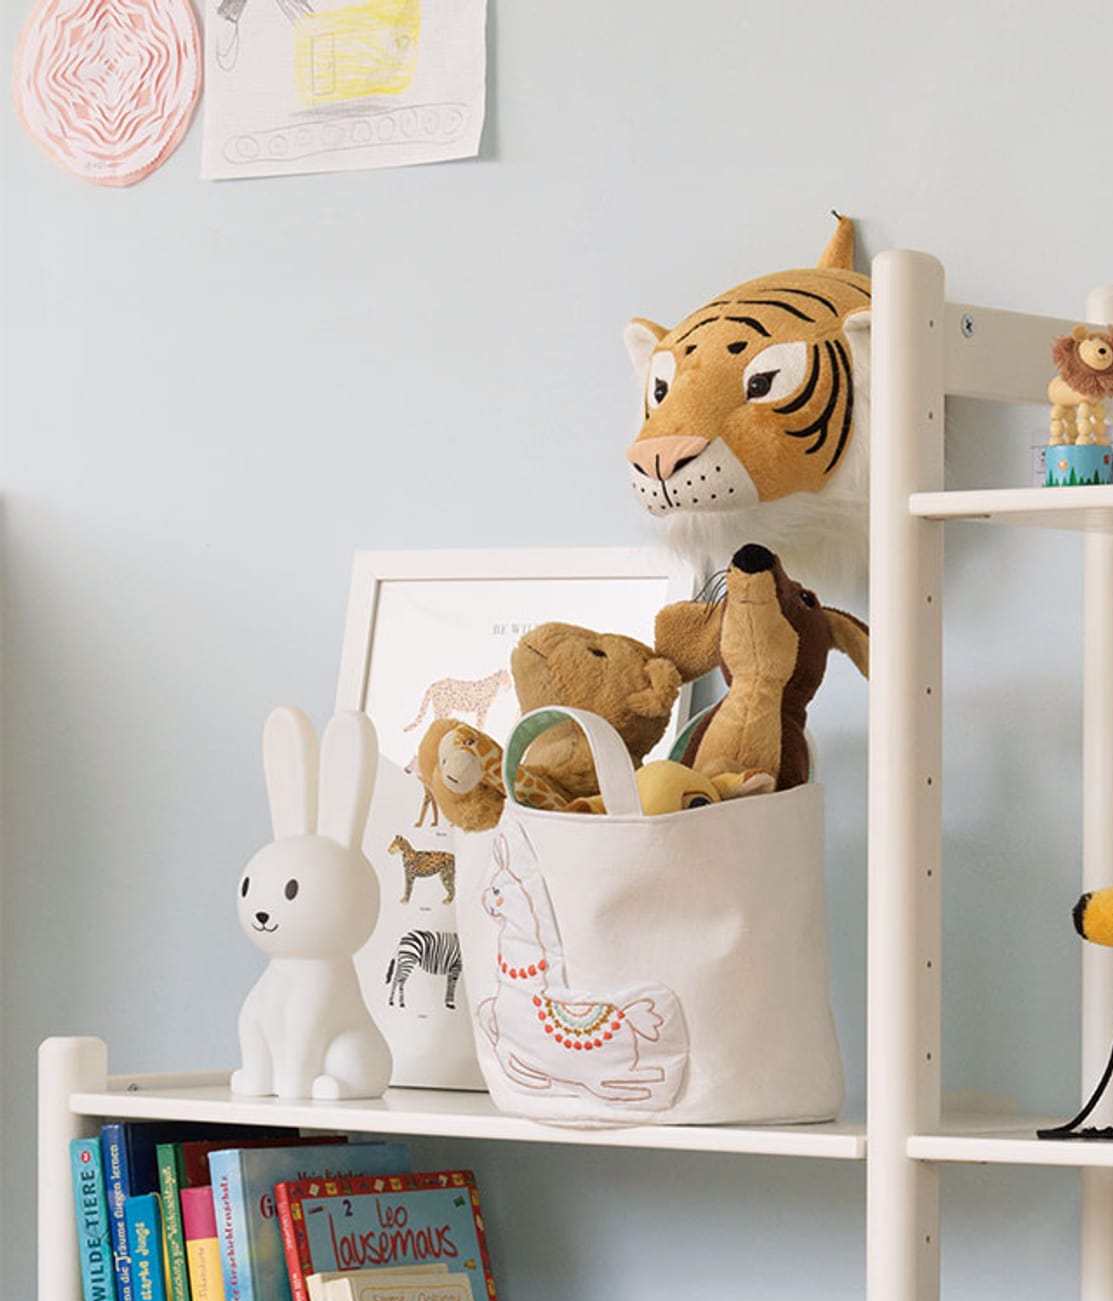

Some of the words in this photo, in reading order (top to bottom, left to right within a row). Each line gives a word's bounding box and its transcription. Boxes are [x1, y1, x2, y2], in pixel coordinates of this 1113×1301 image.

[110, 1144, 121, 1180] lernen
[81, 1170, 99, 1232] TIERE
[113, 1183, 126, 1219] fliegen
[376, 1198, 409, 1230] Leo
[113, 1222, 132, 1272] Träume
[120, 1267, 131, 1283] die
